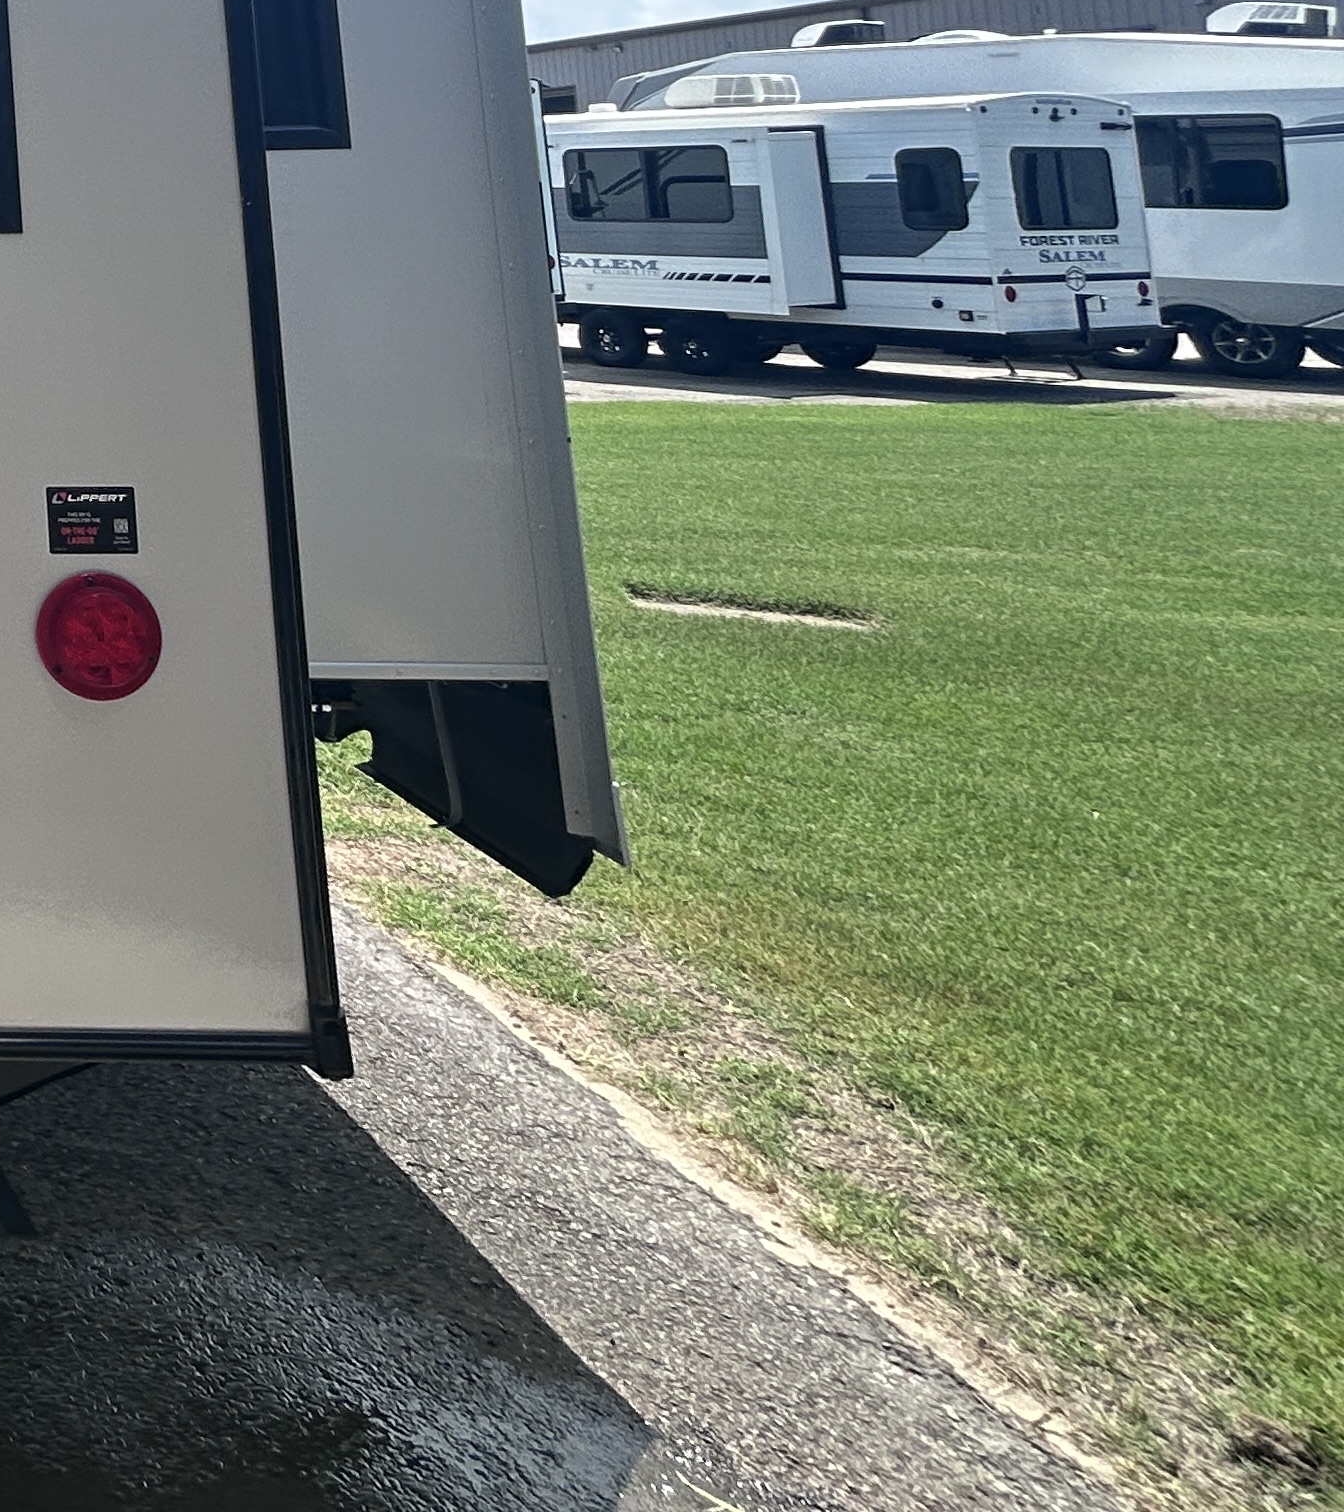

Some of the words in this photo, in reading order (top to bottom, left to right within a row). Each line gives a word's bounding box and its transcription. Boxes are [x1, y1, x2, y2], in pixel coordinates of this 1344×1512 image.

[1019, 235, 1074, 246] FOREST
[1078, 234, 1120, 245] RIVER
[560, 255, 660, 270] SALEM
[1039, 249, 1106, 263] SALEM
[67, 494, 127, 502] LIPPERT
